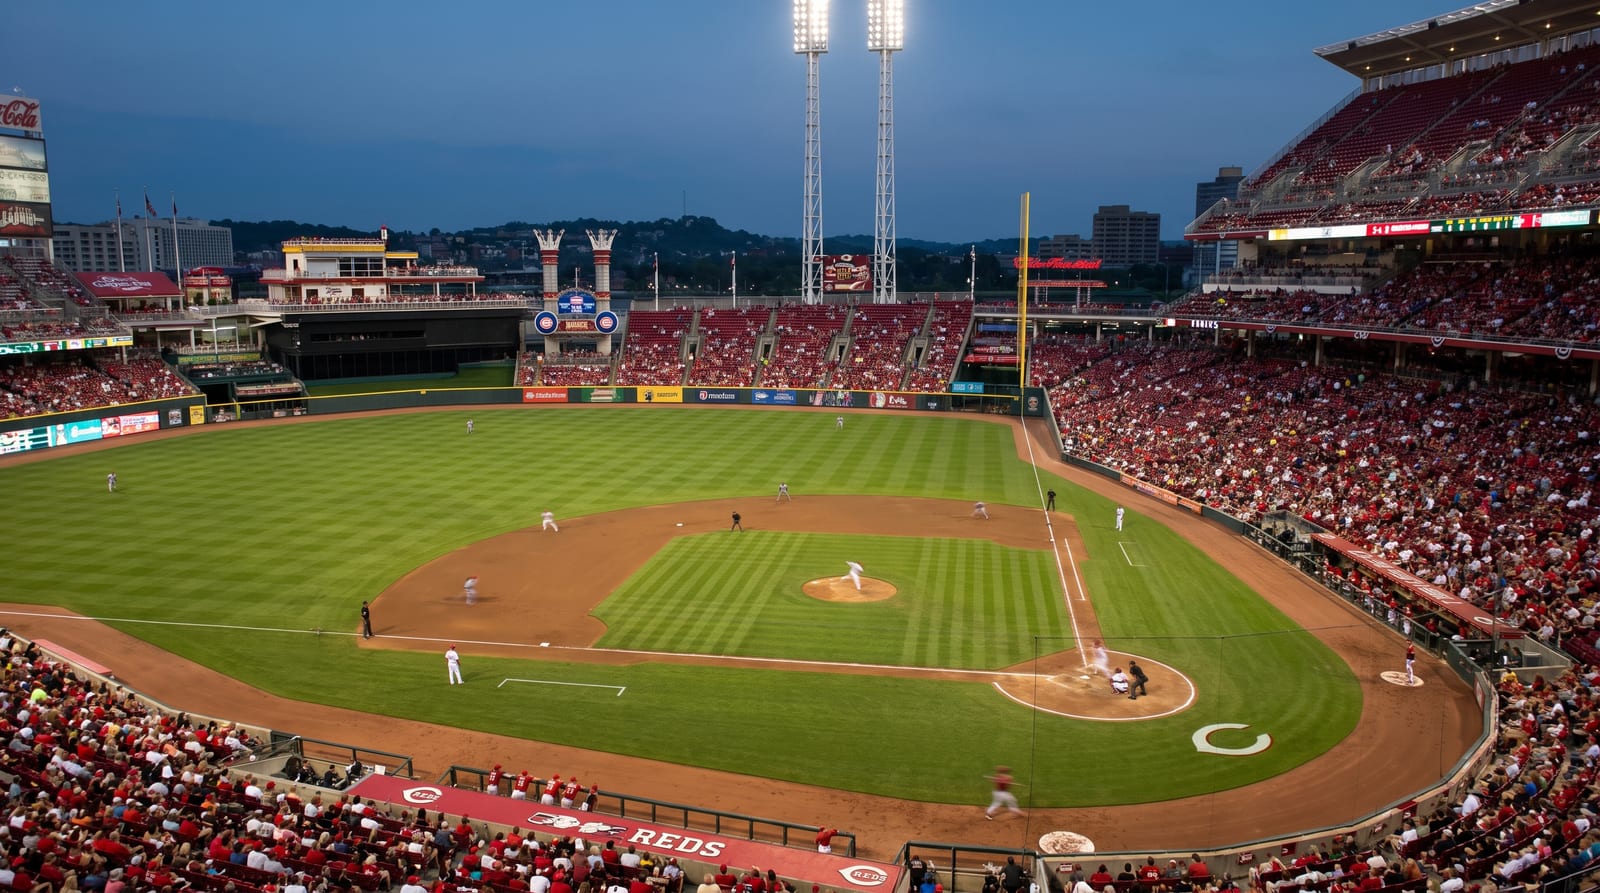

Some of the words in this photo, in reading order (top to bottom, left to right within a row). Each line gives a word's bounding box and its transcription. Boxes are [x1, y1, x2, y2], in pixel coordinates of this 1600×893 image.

[3, 100, 39, 128] Cola
[627, 828, 726, 857] REDS
[853, 871, 888, 882] REDS
